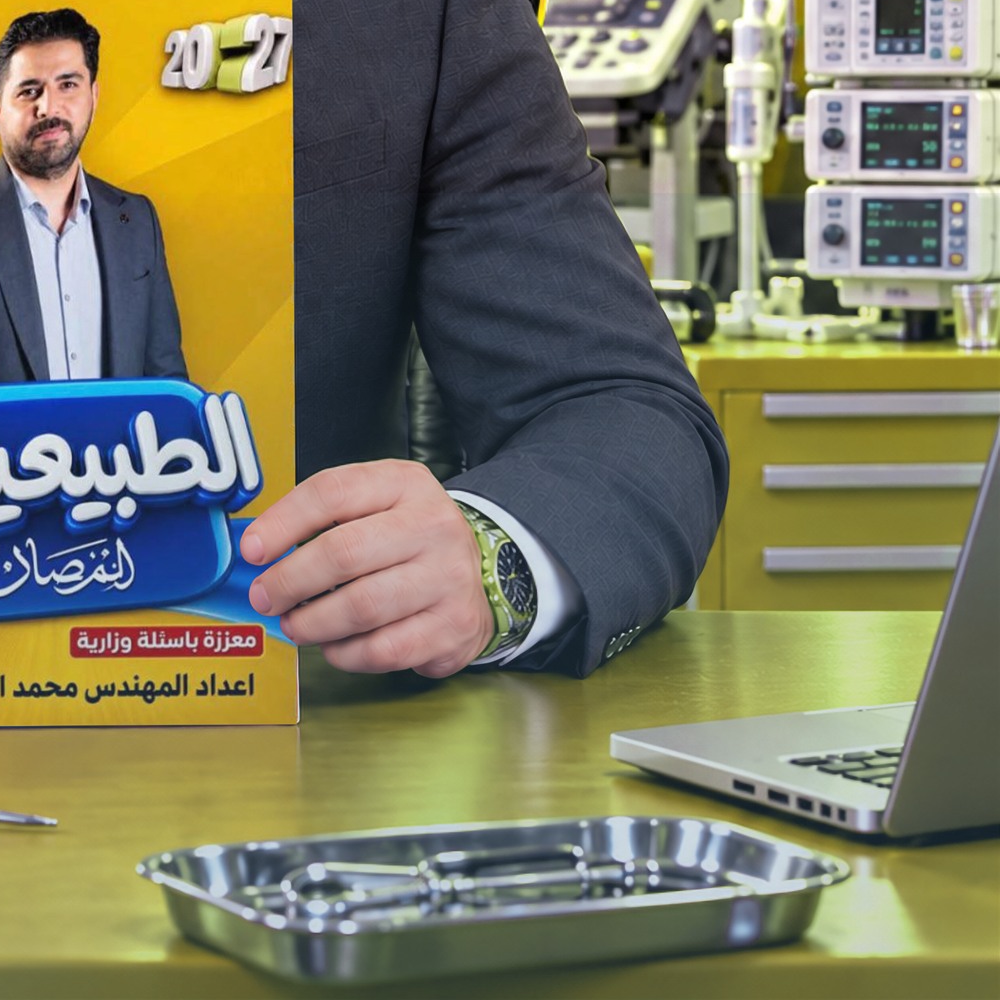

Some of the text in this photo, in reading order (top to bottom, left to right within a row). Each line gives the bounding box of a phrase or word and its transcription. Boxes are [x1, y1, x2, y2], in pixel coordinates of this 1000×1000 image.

[77, 631, 132, 654] وزارية
[203, 630, 257, 653] معززة
[12, 677, 79, 698] محمد
[84, 674, 189, 704] المهندس
[196, 673, 255, 697] اعداد
